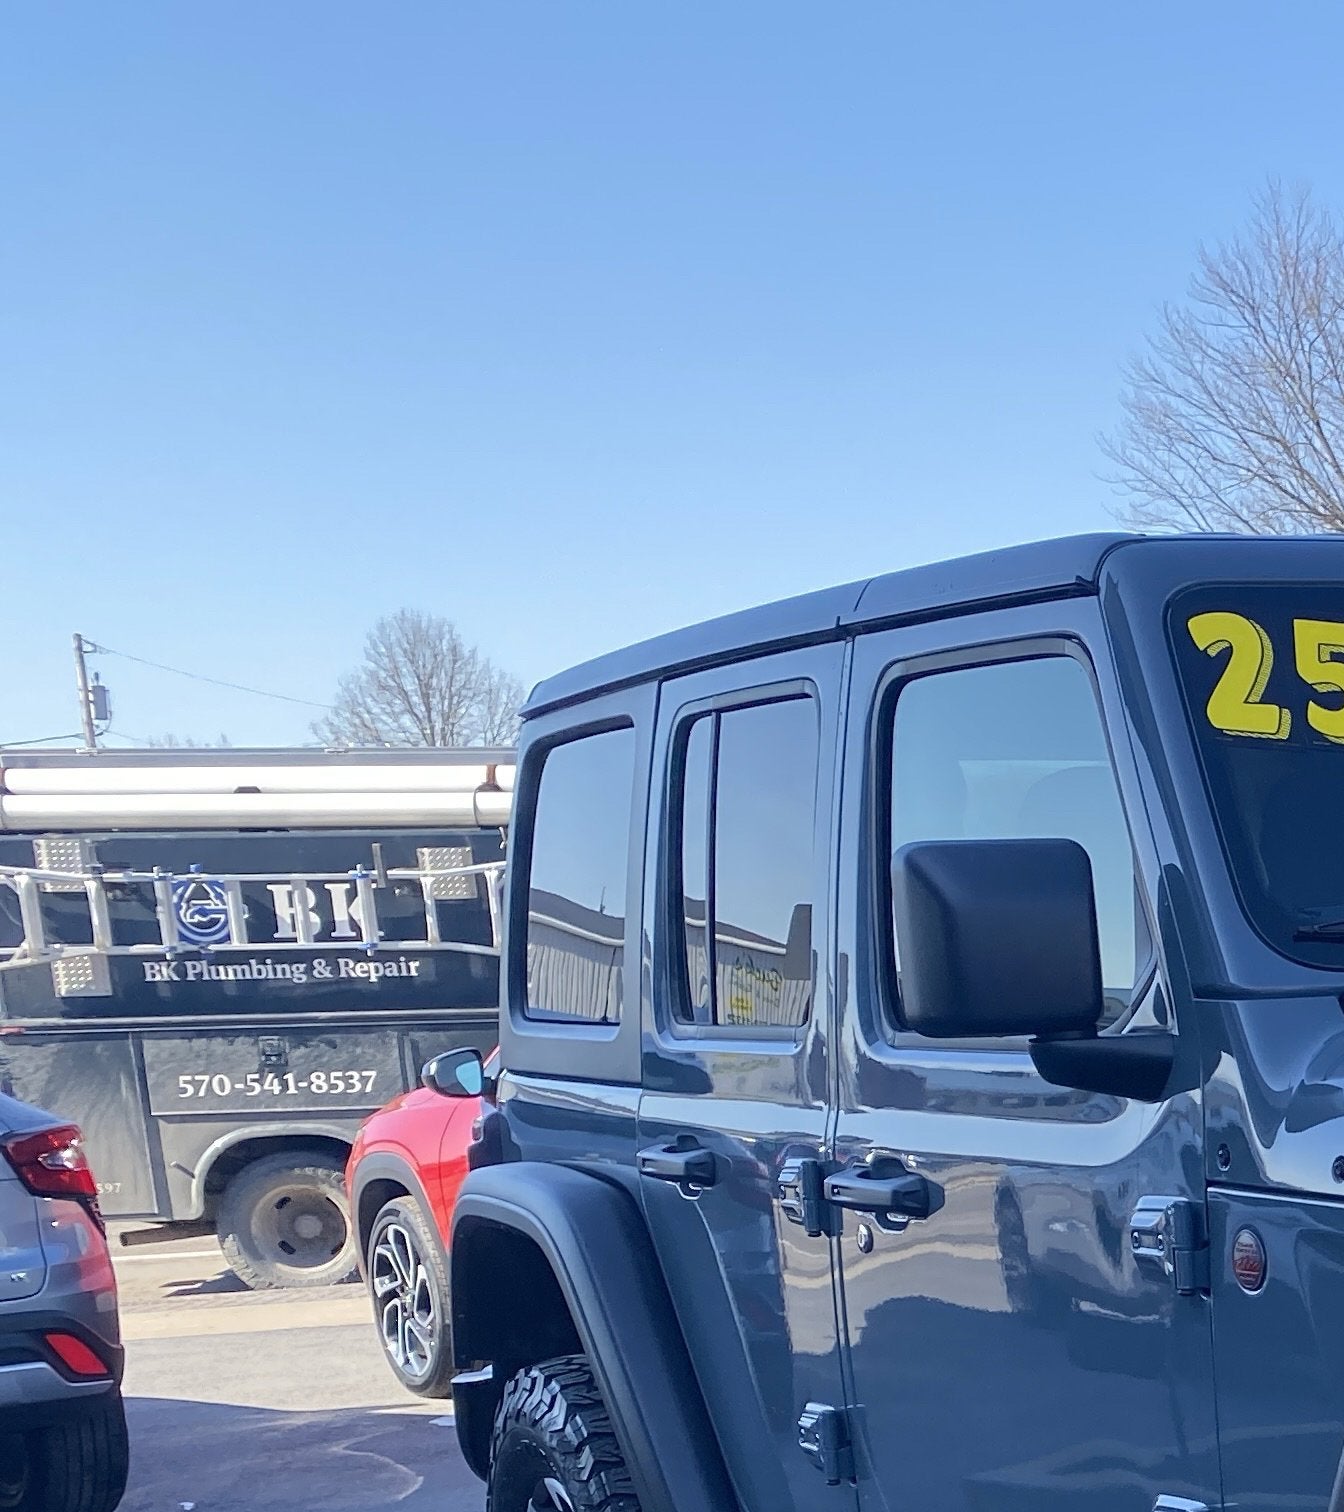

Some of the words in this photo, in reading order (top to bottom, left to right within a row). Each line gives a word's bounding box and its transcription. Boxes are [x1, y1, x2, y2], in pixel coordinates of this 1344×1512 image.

[266, 883, 384, 938] BK
[142, 959, 181, 982] BK
[186, 957, 307, 984] Plumbing
[312, 958, 334, 979] &
[338, 957, 421, 983] Repair
[178, 1070, 378, 1098] 570-541-8537
